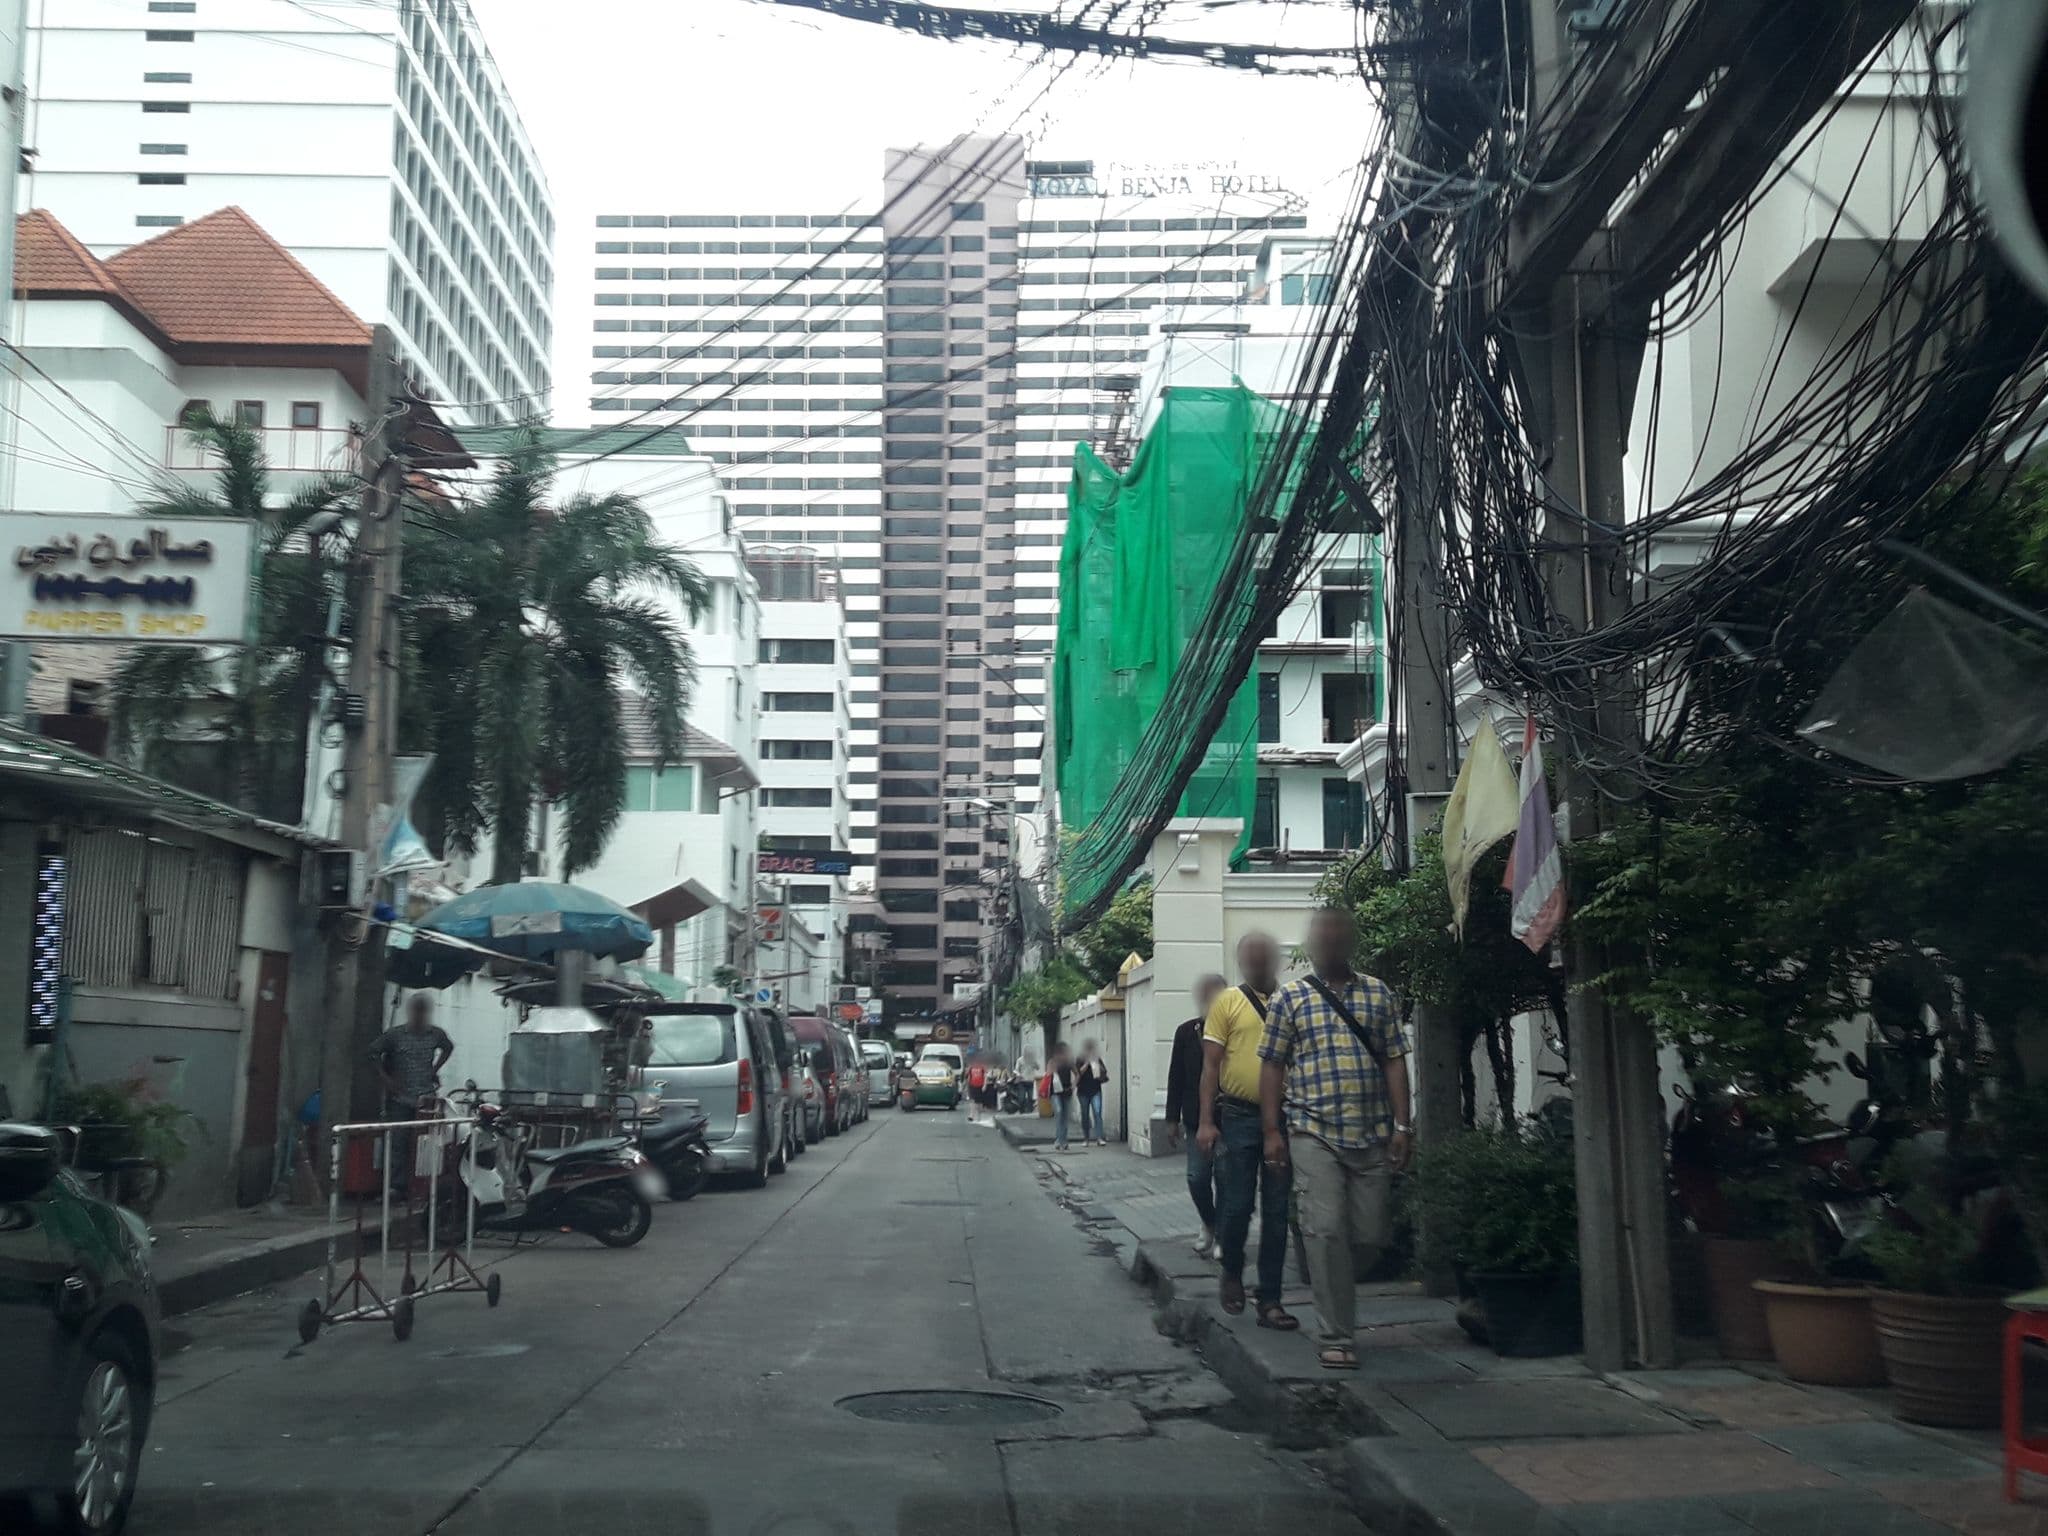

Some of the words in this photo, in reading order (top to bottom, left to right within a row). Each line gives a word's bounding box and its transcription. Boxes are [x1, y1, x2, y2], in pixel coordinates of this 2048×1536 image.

[1121, 175, 1193, 196] BENJA
[1210, 173, 1288, 194] HOTEL
[758, 857, 815, 873] GRACE
